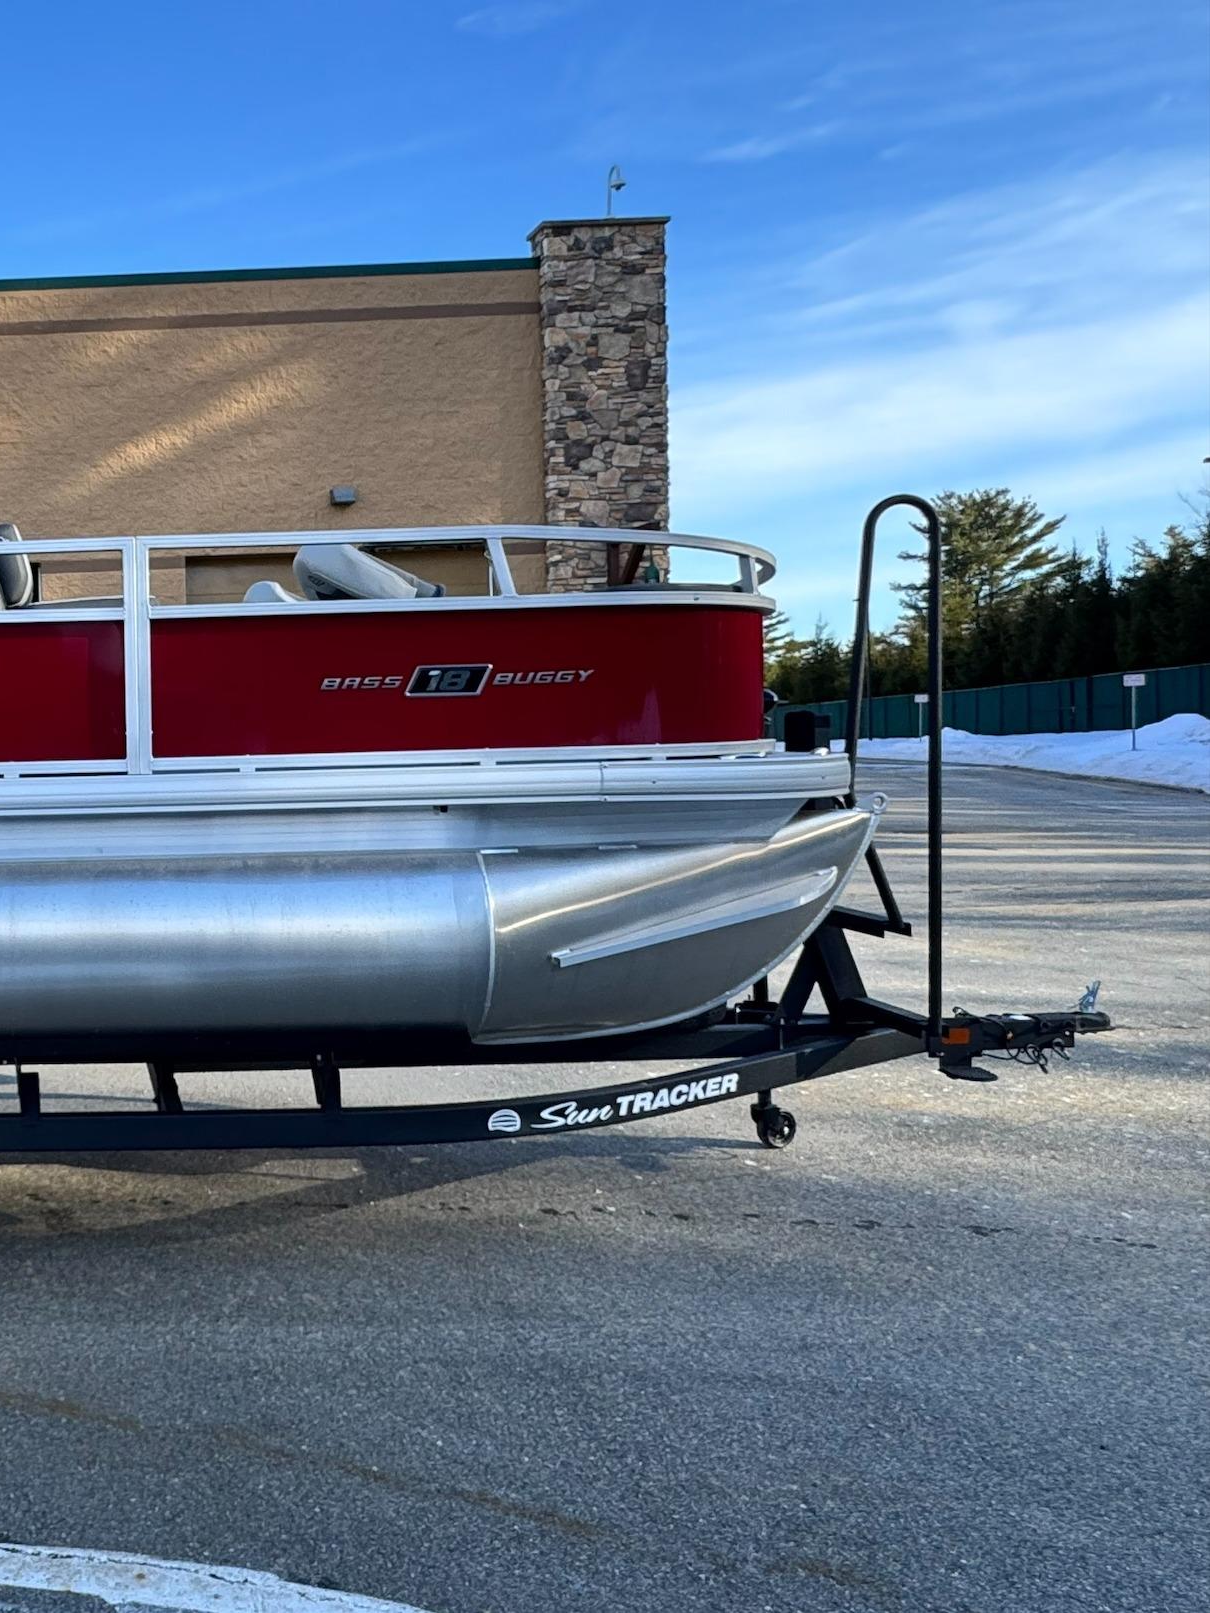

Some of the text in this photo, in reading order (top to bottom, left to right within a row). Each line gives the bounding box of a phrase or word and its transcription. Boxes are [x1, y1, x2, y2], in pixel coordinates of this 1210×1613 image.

[320, 669, 594, 691] BASS 18 BUGGY
[530, 1072, 739, 1129] Sun TRACKER
